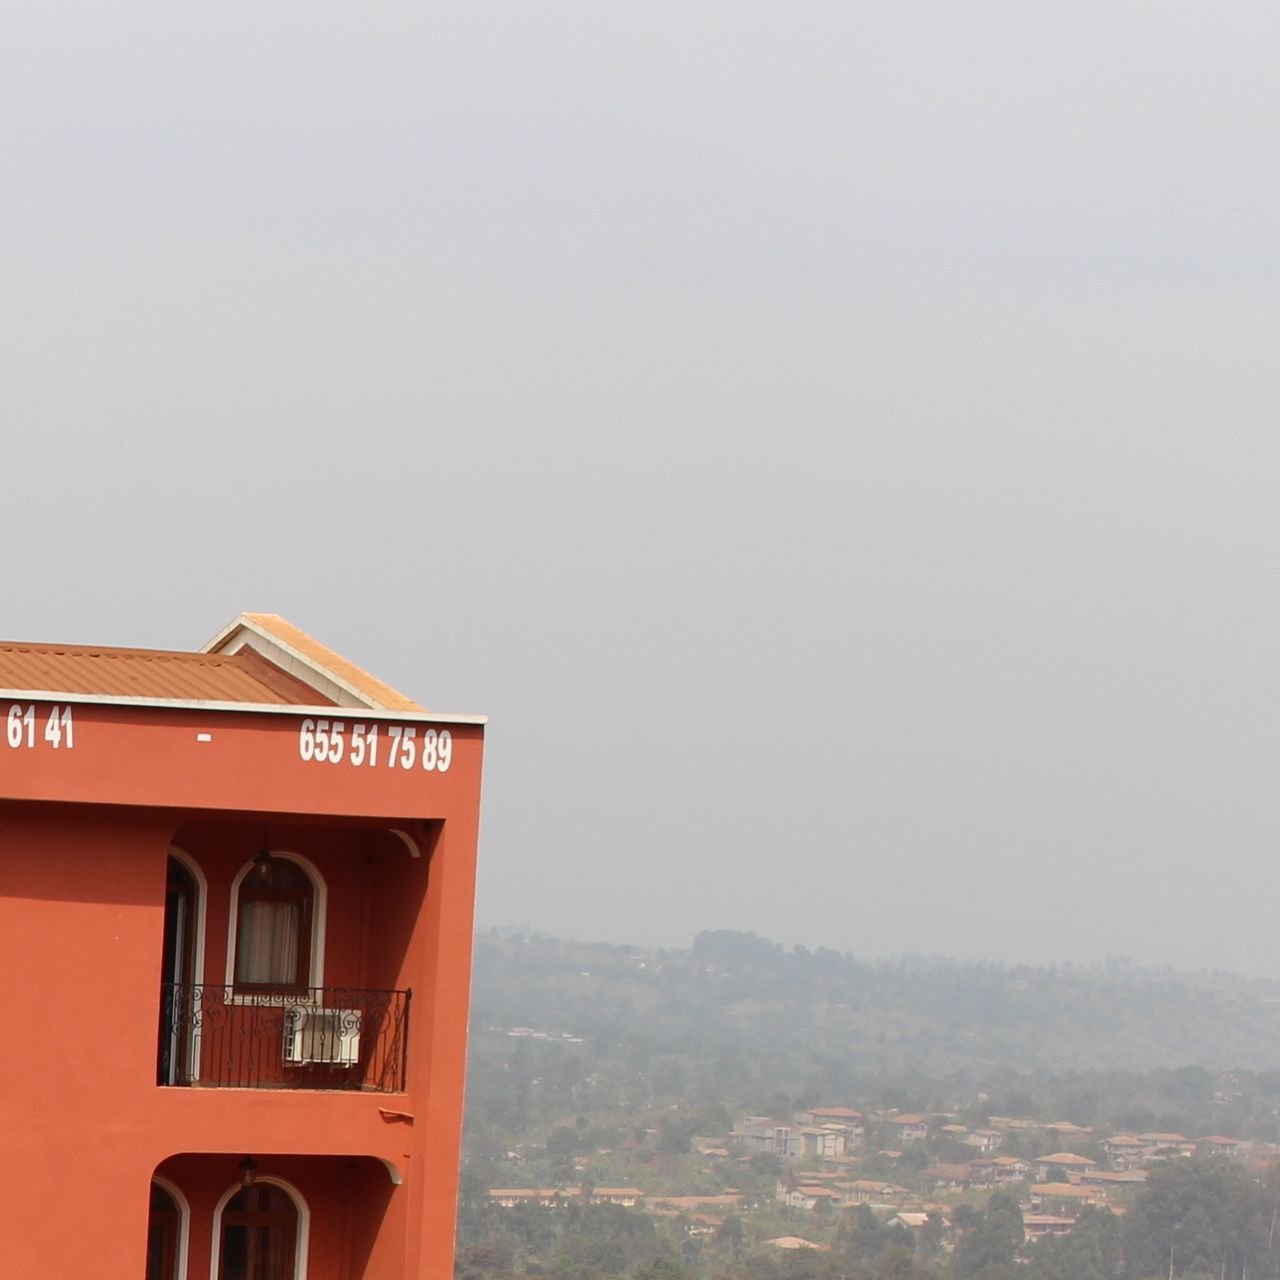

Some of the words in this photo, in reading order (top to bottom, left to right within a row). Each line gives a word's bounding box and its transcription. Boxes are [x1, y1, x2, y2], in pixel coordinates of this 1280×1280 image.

[7, 704, 36, 749] 61
[44, 705, 74, 749] 41
[299, 718, 345, 764] 655
[350, 723, 379, 767] 51
[388, 726, 417, 770] 75
[422, 728, 453, 773] 89
